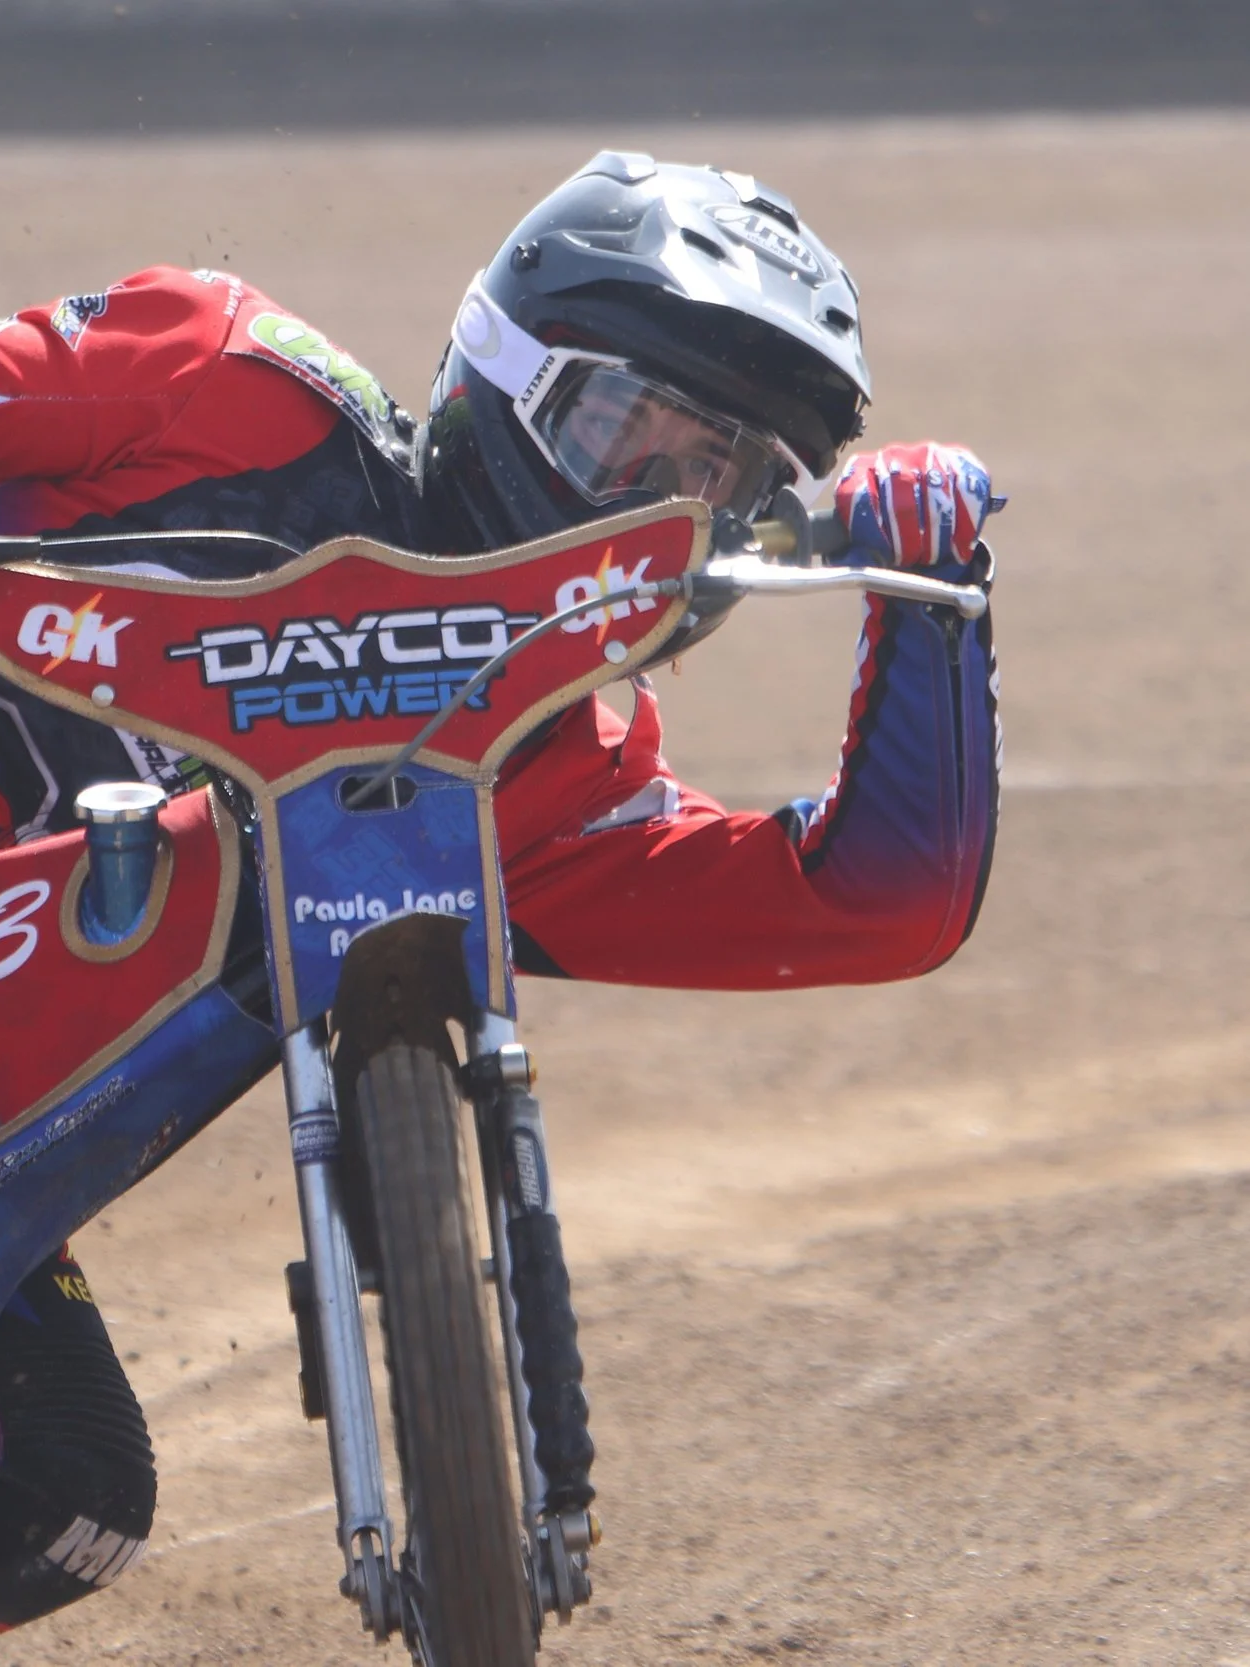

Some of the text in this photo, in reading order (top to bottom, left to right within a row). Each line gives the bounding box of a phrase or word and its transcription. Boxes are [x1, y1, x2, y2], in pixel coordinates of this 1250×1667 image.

[520, 354, 555, 407] OAKLEY
[16, 602, 134, 669] GK
[201, 605, 512, 685] DAYCO
[233, 674, 488, 730] POWER
[294, 895, 389, 924] Paula
